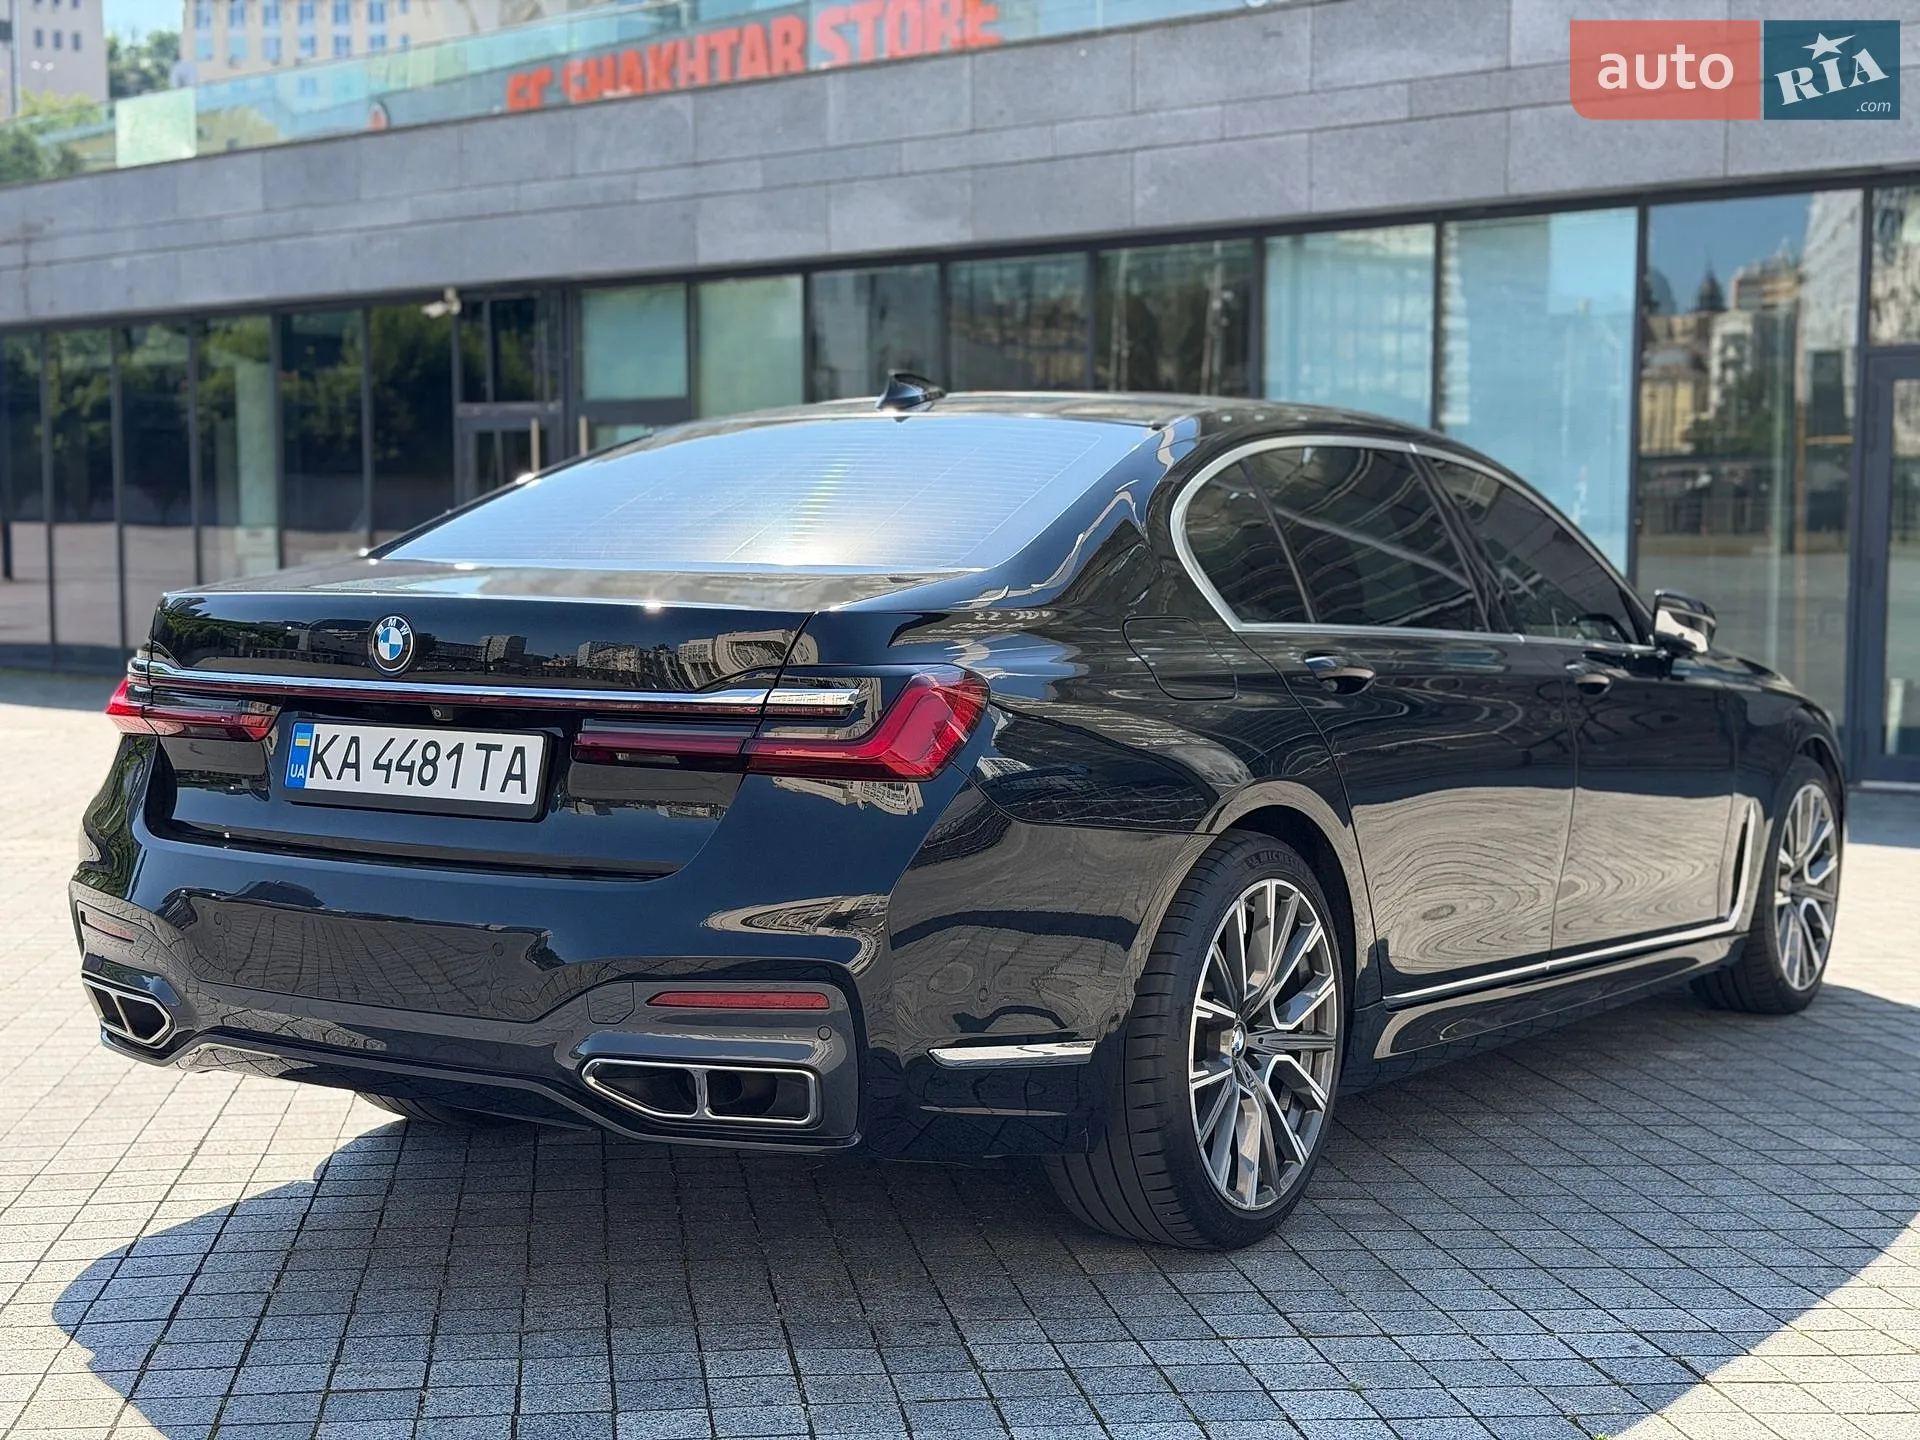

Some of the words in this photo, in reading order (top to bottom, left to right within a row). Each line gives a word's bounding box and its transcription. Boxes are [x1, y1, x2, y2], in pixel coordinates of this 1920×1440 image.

[815, 0, 1002, 67] STORE
[376, 618, 409, 637] BMW
[290, 763, 306, 779] UA
[308, 733, 361, 782] KA
[372, 737, 465, 790] 4481
[475, 742, 528, 795] TA
